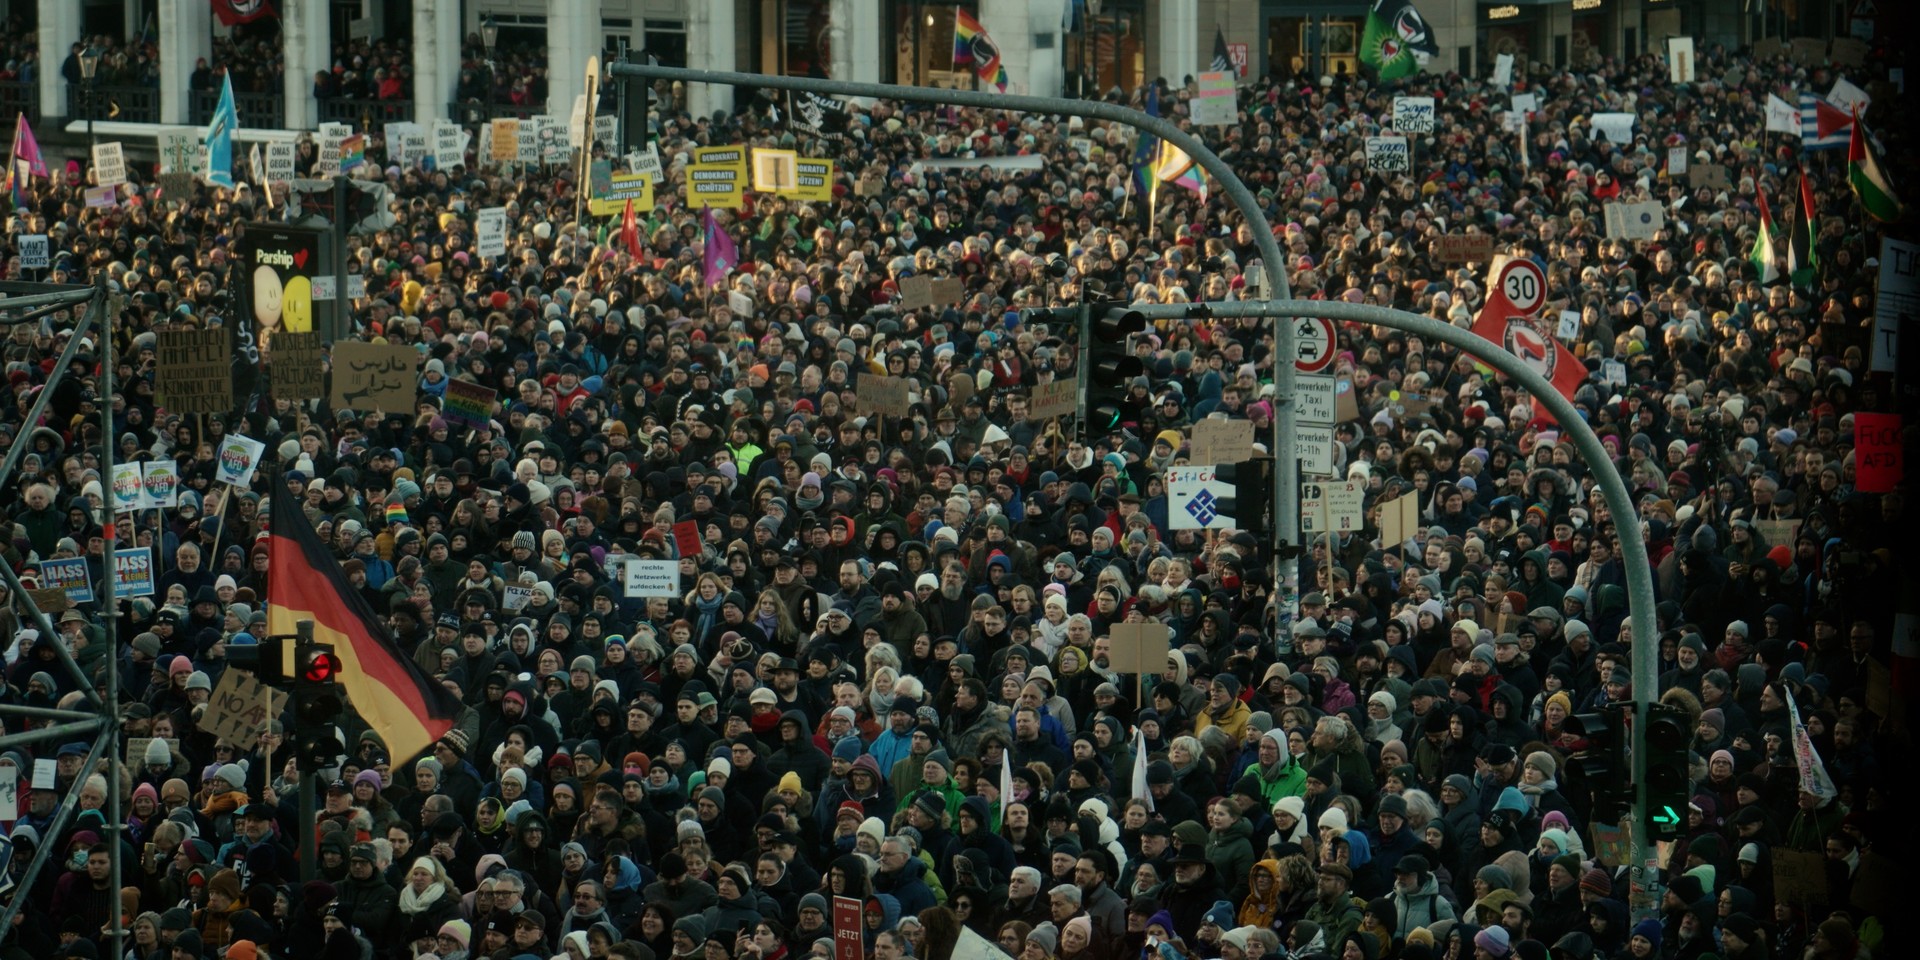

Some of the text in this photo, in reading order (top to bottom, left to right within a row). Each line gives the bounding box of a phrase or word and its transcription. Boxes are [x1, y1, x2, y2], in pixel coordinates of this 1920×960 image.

[1395, 118, 1433, 132] RECHTS
[329, 128, 347, 137] OMAS
[439, 128, 456, 137] OMAS
[272, 147, 290, 155] OMAS
[702, 152, 739, 162] DEMOKRATIE
[270, 160, 292, 169] GEGEN
[635, 160, 657, 170] GEGEN
[1369, 158, 1407, 169] RECHTS
[268, 171, 293, 180] RECHTS
[694, 171, 736, 180] DEMOKRATIE
[697, 182, 733, 192] SCHÜTZEN!
[20, 241, 46, 249] LAUT
[256, 249, 294, 270] Parship
[1507, 276, 1535, 300] 30
[272, 366, 322, 385] HALTUNG
[1295, 382, 1332, 393] enverkehr
[1304, 393, 1323, 405] Taxi
[1313, 407, 1330, 418] frei
[1860, 423, 1903, 446] FUCK
[228, 458, 242, 471] AFD
[1303, 460, 1315, 468] rei
[1862, 450, 1897, 469] AFD
[154, 482, 168, 494] AFD
[46, 564, 85, 579] HASS
[125, 571, 149, 583] KEINE
[634, 572, 672, 581] Netzwerke
[63, 579, 88, 588] KEINE
[629, 582, 666, 592] aufdecken
[218, 691, 240, 713] NO
[844, 915, 852, 923] IST
[837, 928, 860, 941] JETZT
